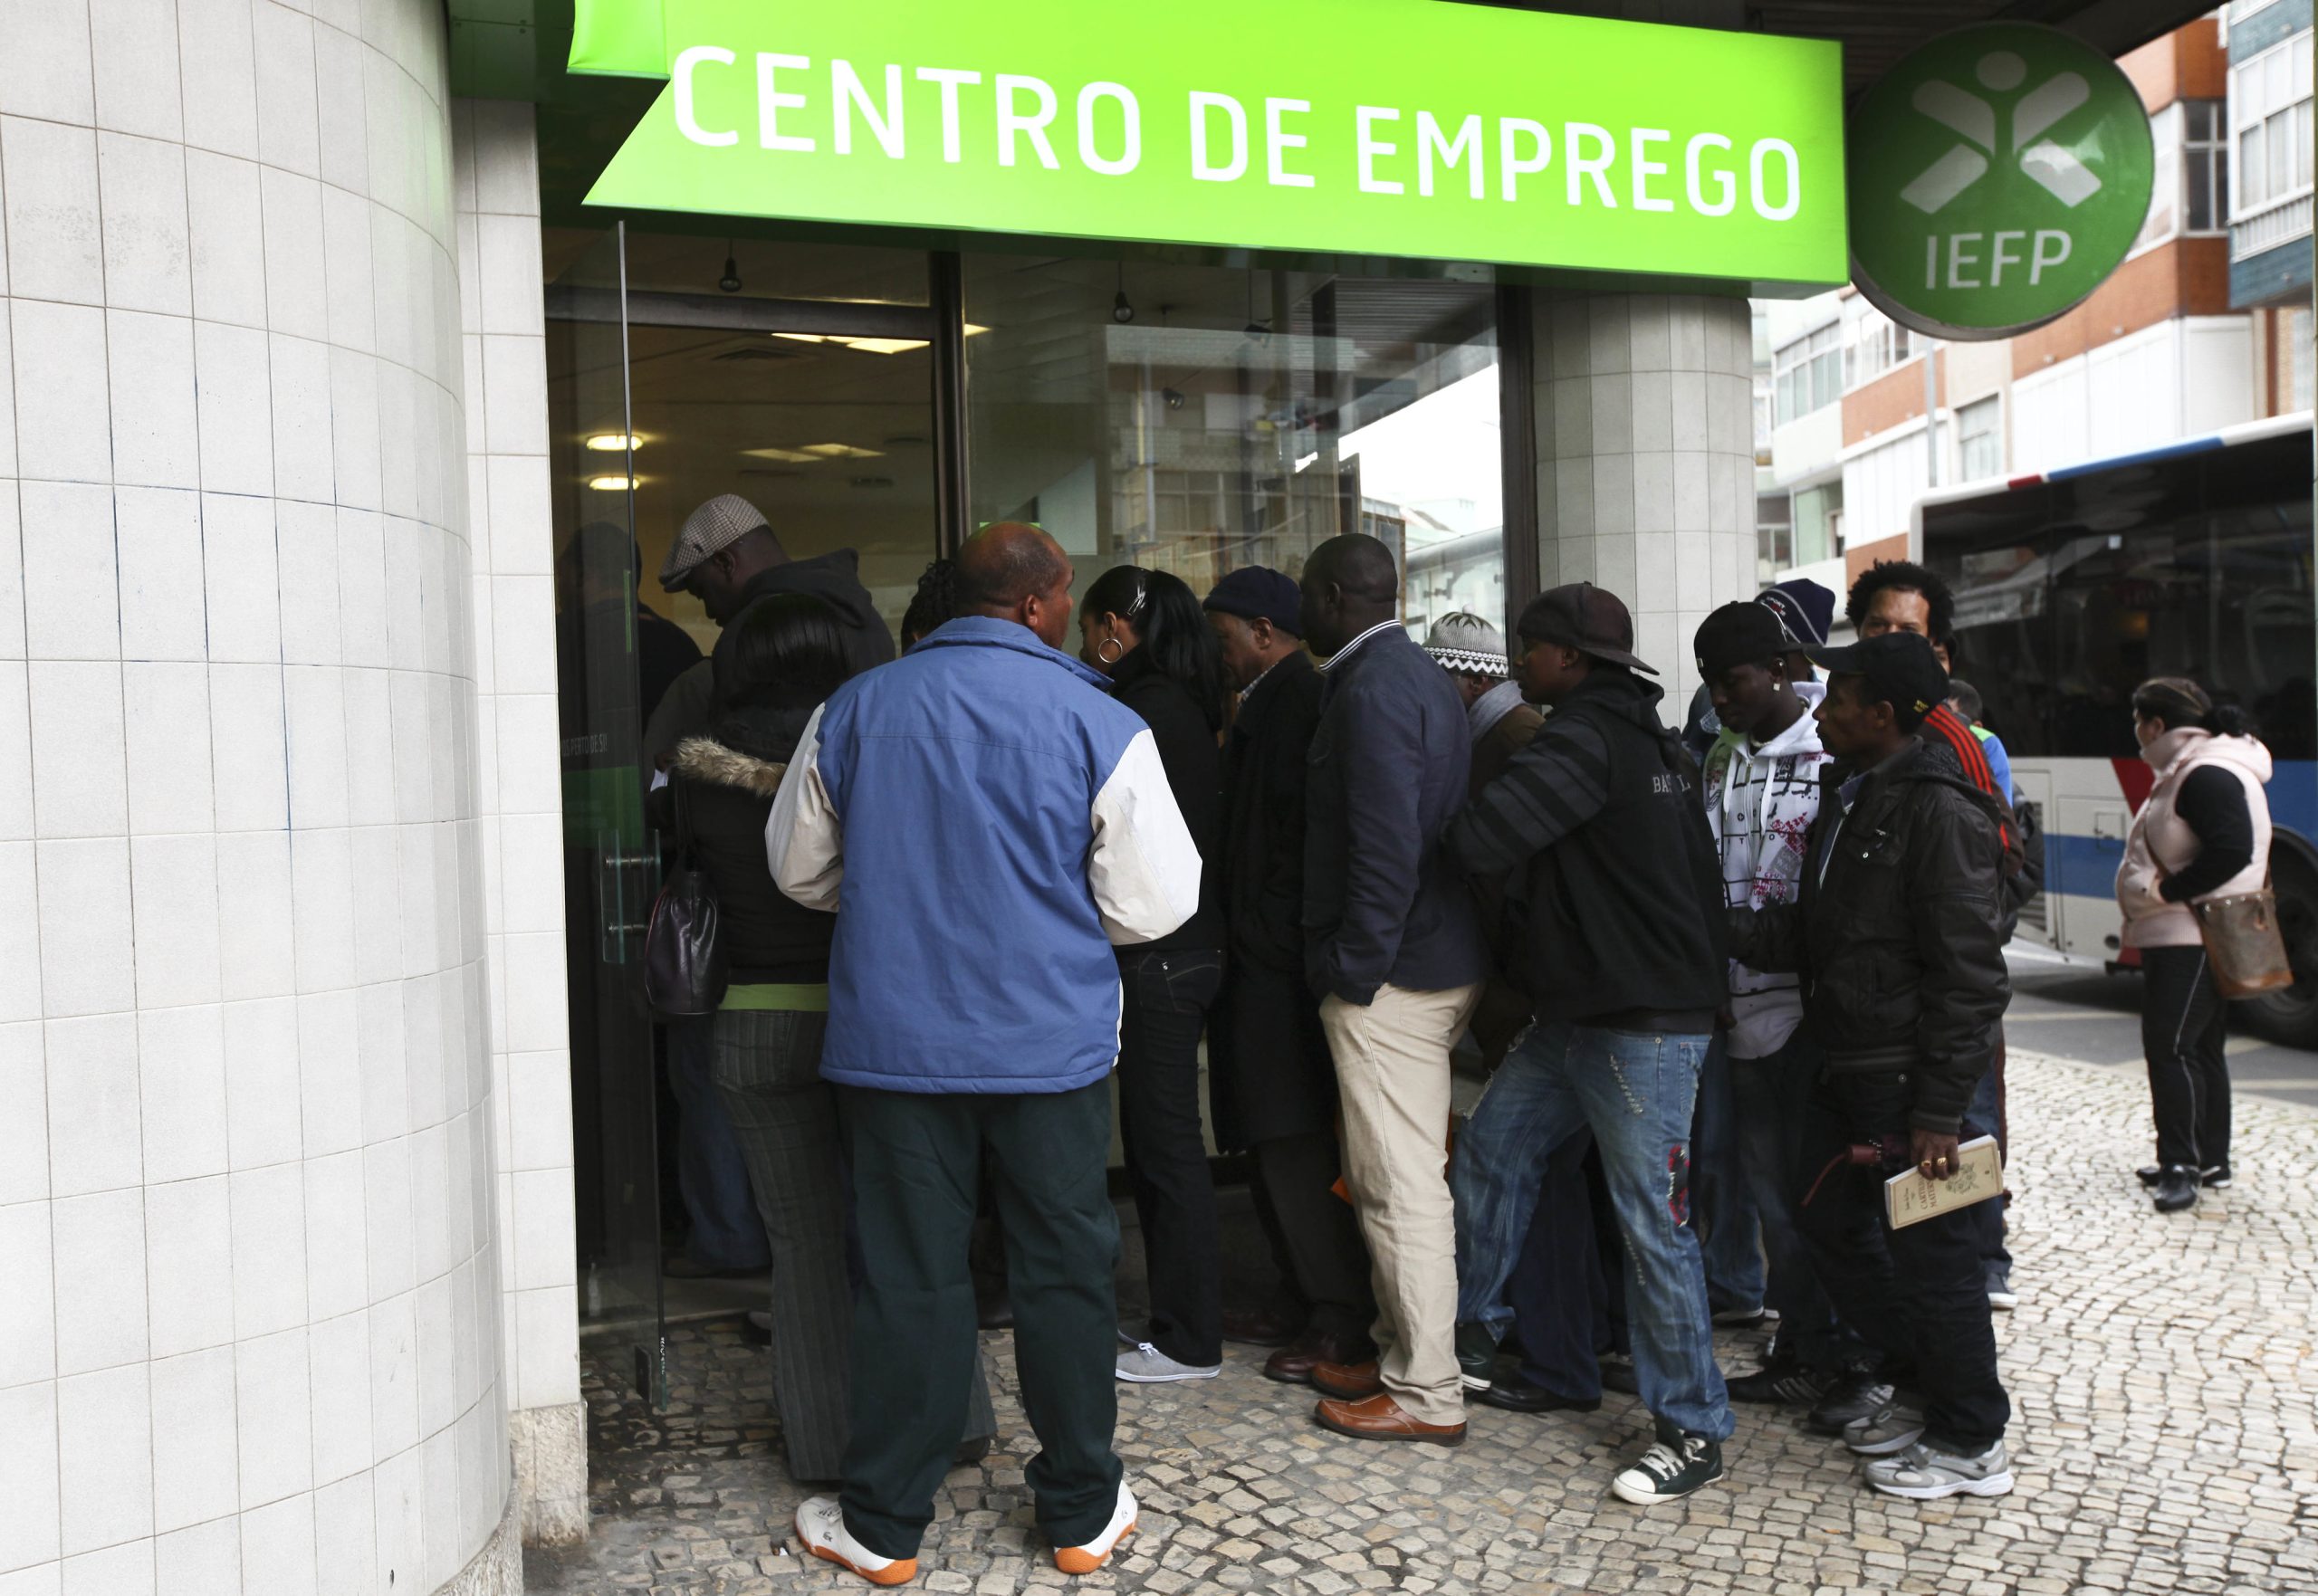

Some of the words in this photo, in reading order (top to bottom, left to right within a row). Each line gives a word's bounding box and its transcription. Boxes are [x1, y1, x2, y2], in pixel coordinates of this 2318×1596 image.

[673, 45, 1141, 175] CENTRO
[1189, 91, 1315, 187] DE
[1356, 106, 1801, 221] EMPREGO
[1926, 229, 2073, 290] IEFP
